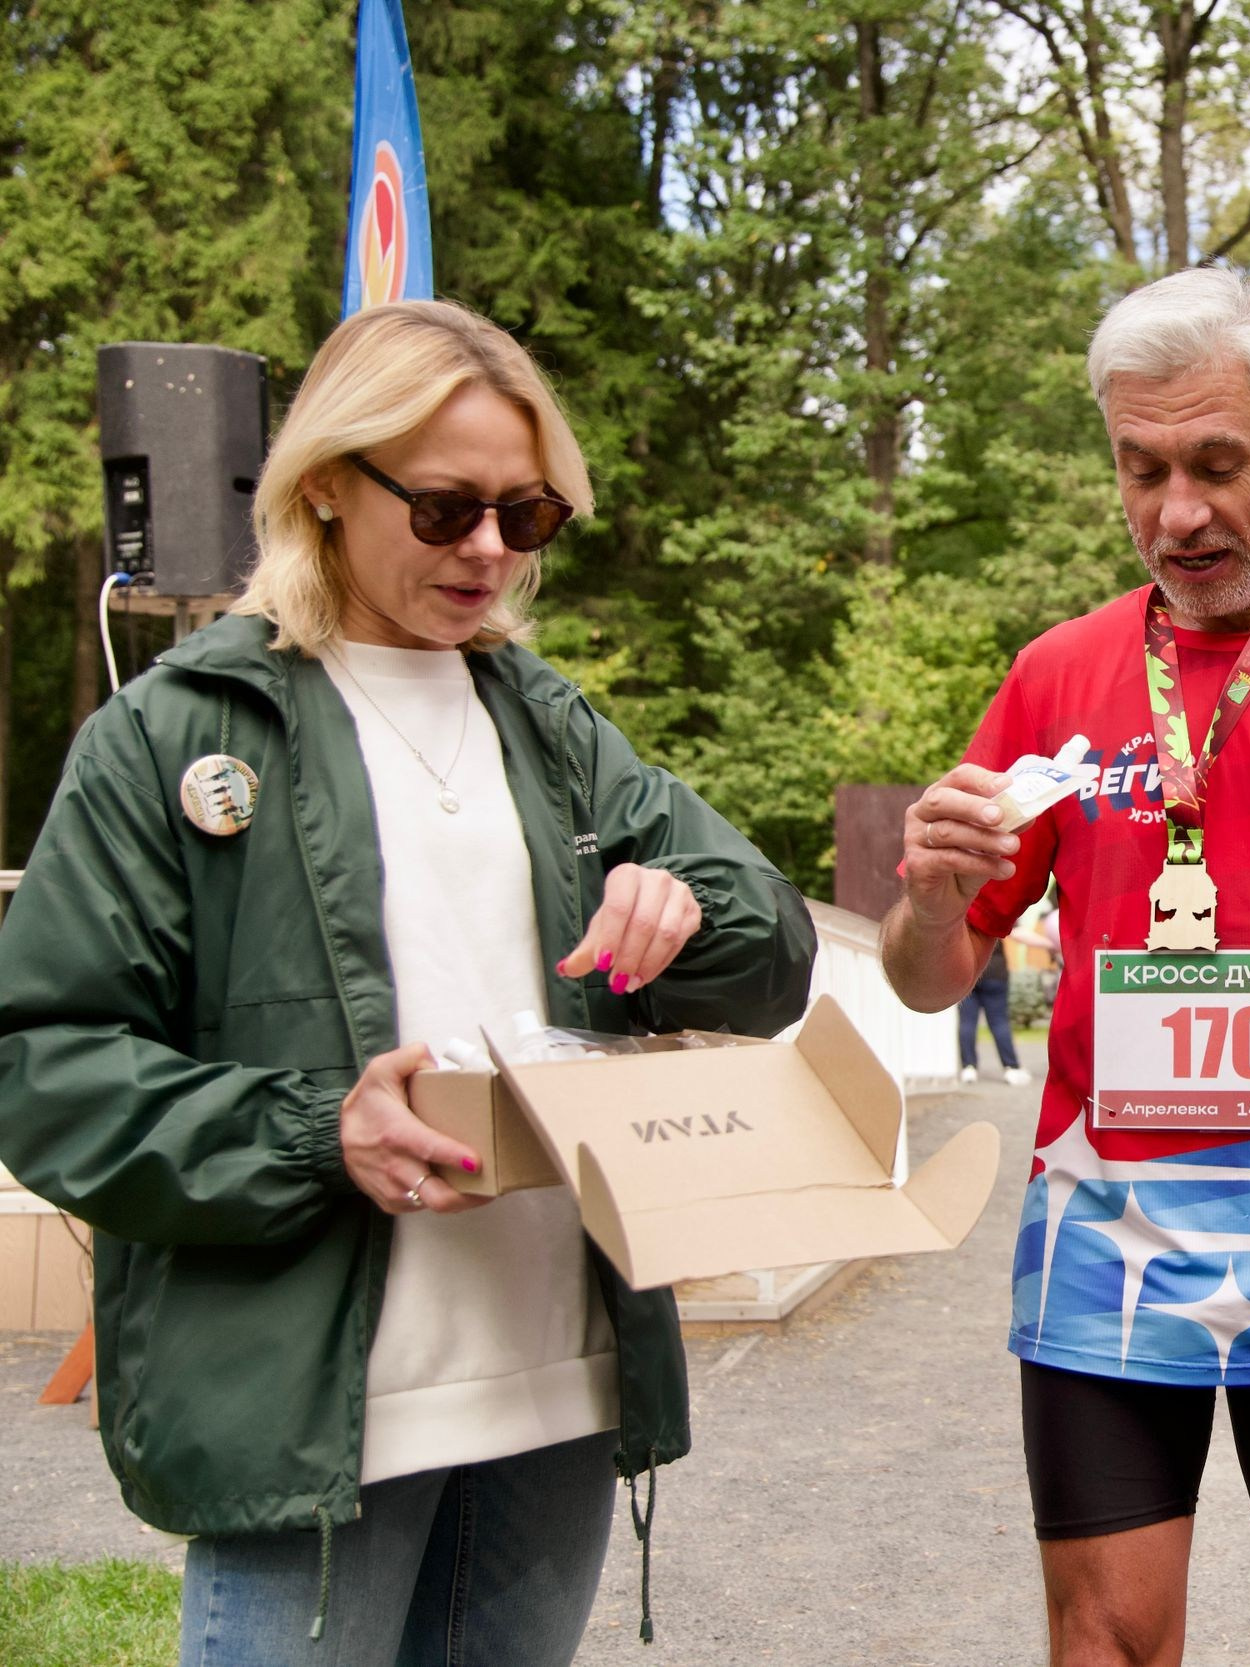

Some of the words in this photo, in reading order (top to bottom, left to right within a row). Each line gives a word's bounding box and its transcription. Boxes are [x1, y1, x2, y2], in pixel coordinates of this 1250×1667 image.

[1121, 732, 1156, 757] КРА
[1124, 964, 1218, 985] КРОСС
[1121, 1101, 1219, 1120] Апрелевка
